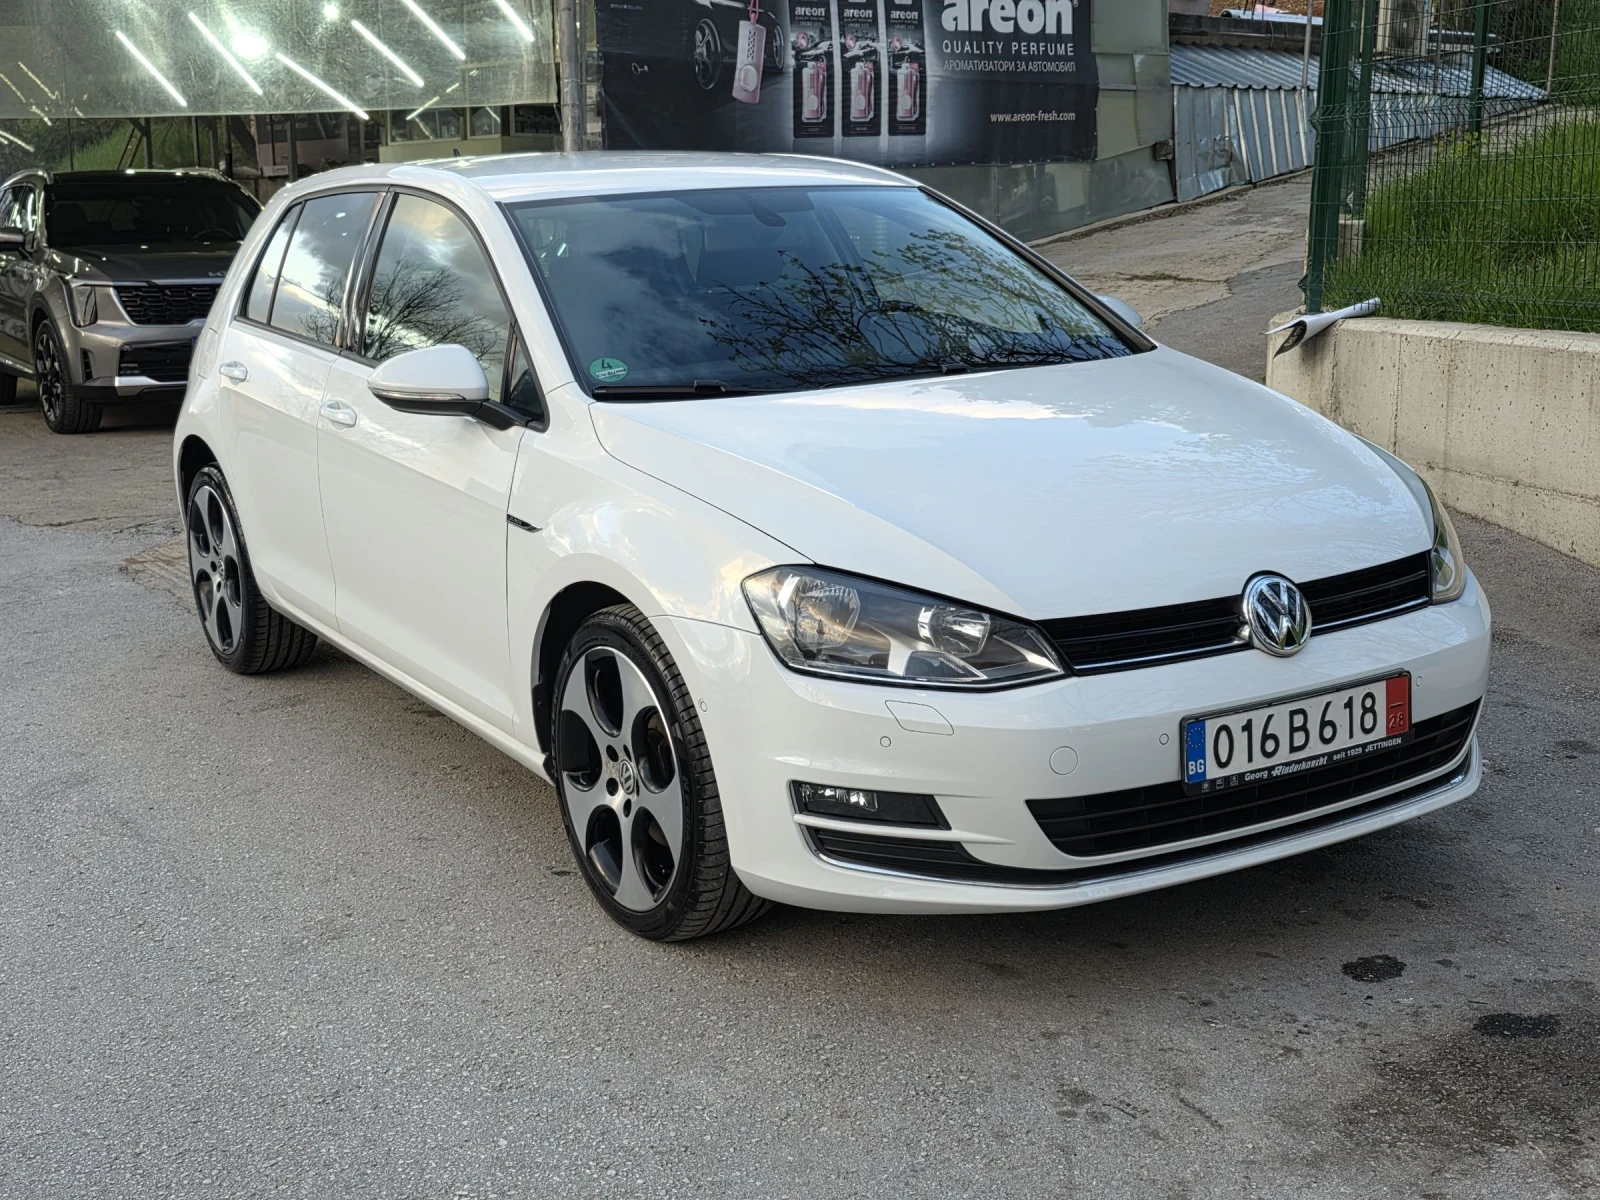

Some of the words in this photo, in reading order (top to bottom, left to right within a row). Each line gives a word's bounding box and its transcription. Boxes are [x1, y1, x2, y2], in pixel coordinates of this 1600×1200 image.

[795, 6, 826, 16] areon
[843, 9, 873, 18] areon
[890, 10, 919, 20] areon
[941, 0, 1073, 34] areon
[942, 40, 1004, 54] QUALITY
[1012, 42, 1074, 56] PERFUME
[944, 60, 1015, 71] АРОМАТИЗАТОРИ
[1016, 61, 1026, 72] ЗА
[1028, 61, 1076, 72] АВТОМОБИЛ
[990, 110, 1076, 122] www.areon-fresh.com
[1213, 691, 1378, 768] 016B618
[1244, 769, 1268, 781] Georg
[1333, 751, 1346, 760] seit
[1347, 747, 1362, 757] 1929
[1365, 737, 1402, 752] JETTINGEN
[1188, 759, 1205, 775] BG
